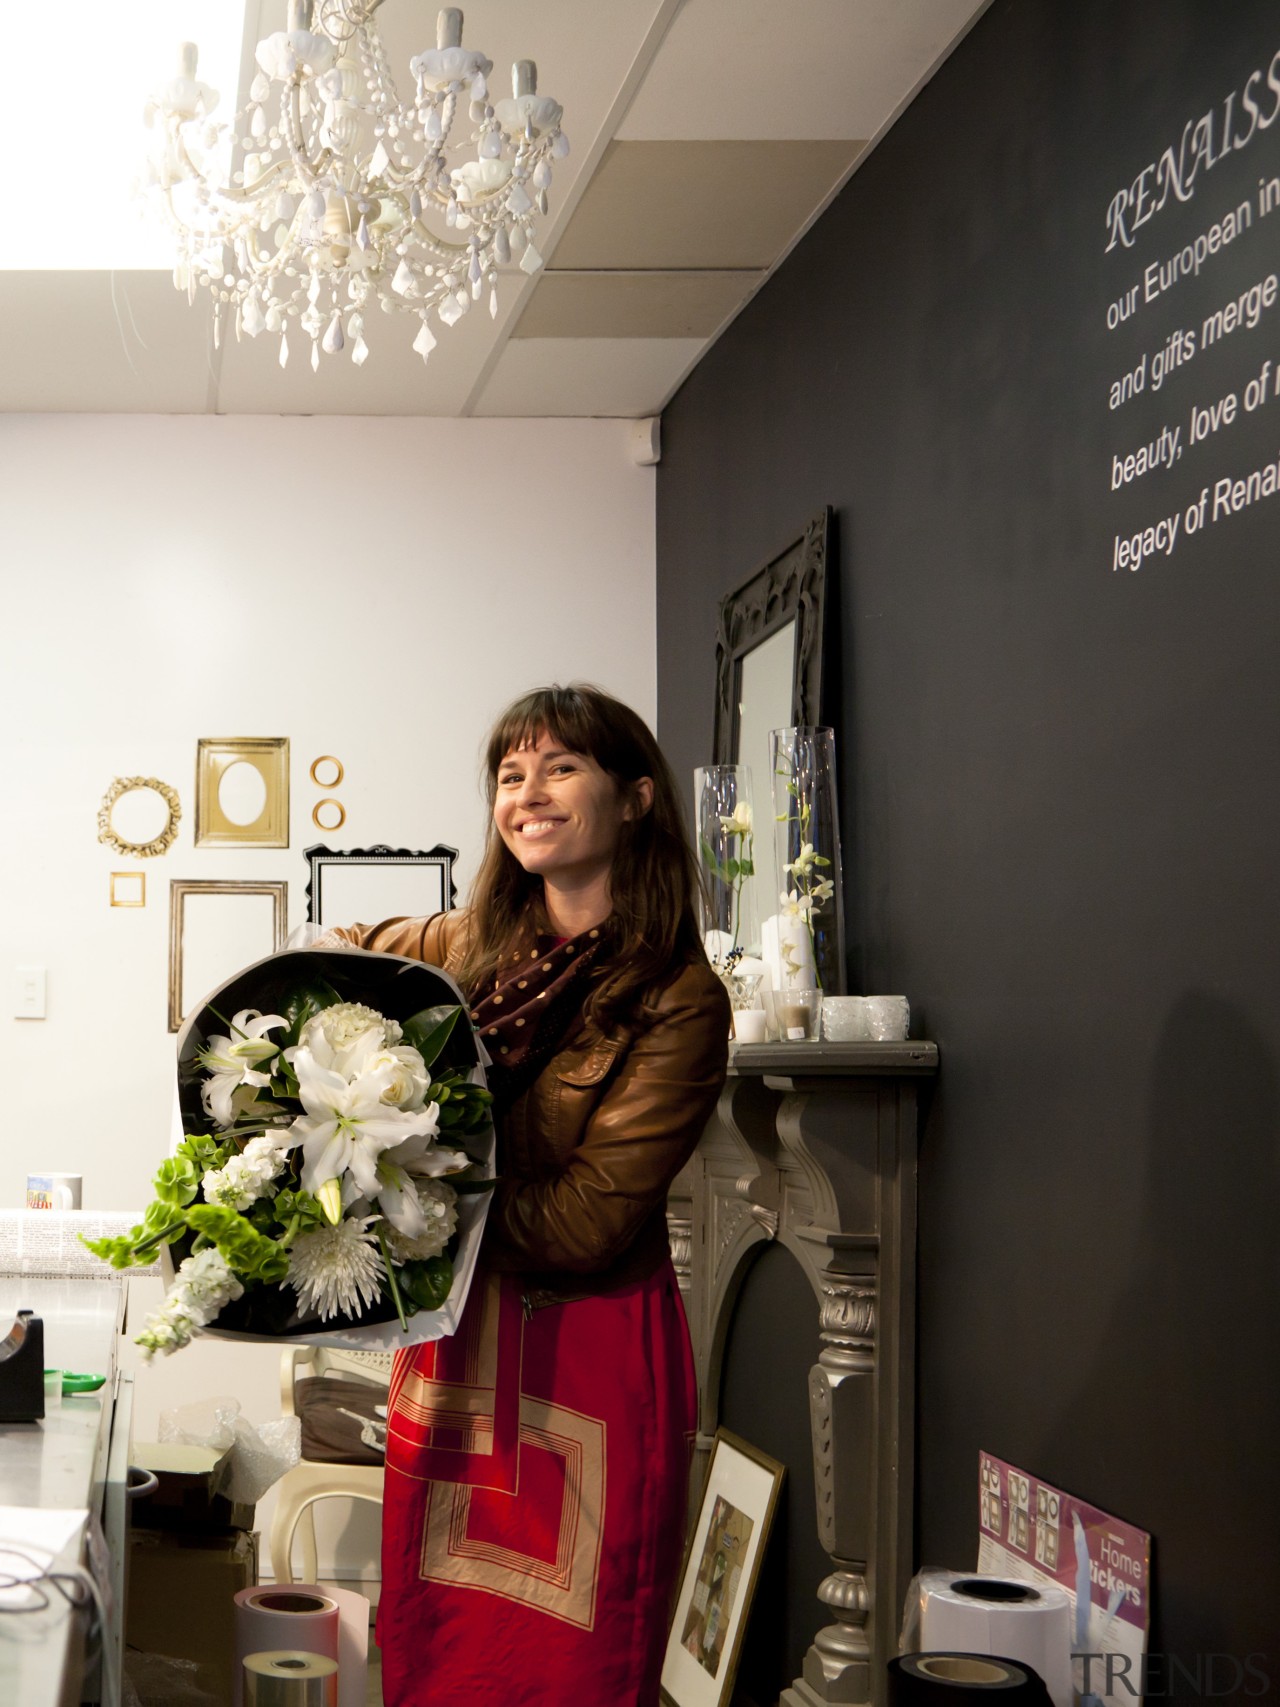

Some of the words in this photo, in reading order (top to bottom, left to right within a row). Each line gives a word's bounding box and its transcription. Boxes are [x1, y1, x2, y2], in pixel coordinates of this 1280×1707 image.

[1104, 50, 1280, 254] RENAISS
[1107, 284, 1139, 329] our
[1144, 200, 1252, 304] European
[1109, 354, 1146, 410] and
[1151, 329, 1196, 391] gifts
[1201, 274, 1278, 349] merge
[1111, 425, 1183, 491] beauty,
[1189, 393, 1237, 446] love
[1244, 360, 1271, 412] of
[1113, 513, 1180, 572] legacy
[1184, 488, 1209, 534] of
[1101, 1538, 1141, 1579] Home
